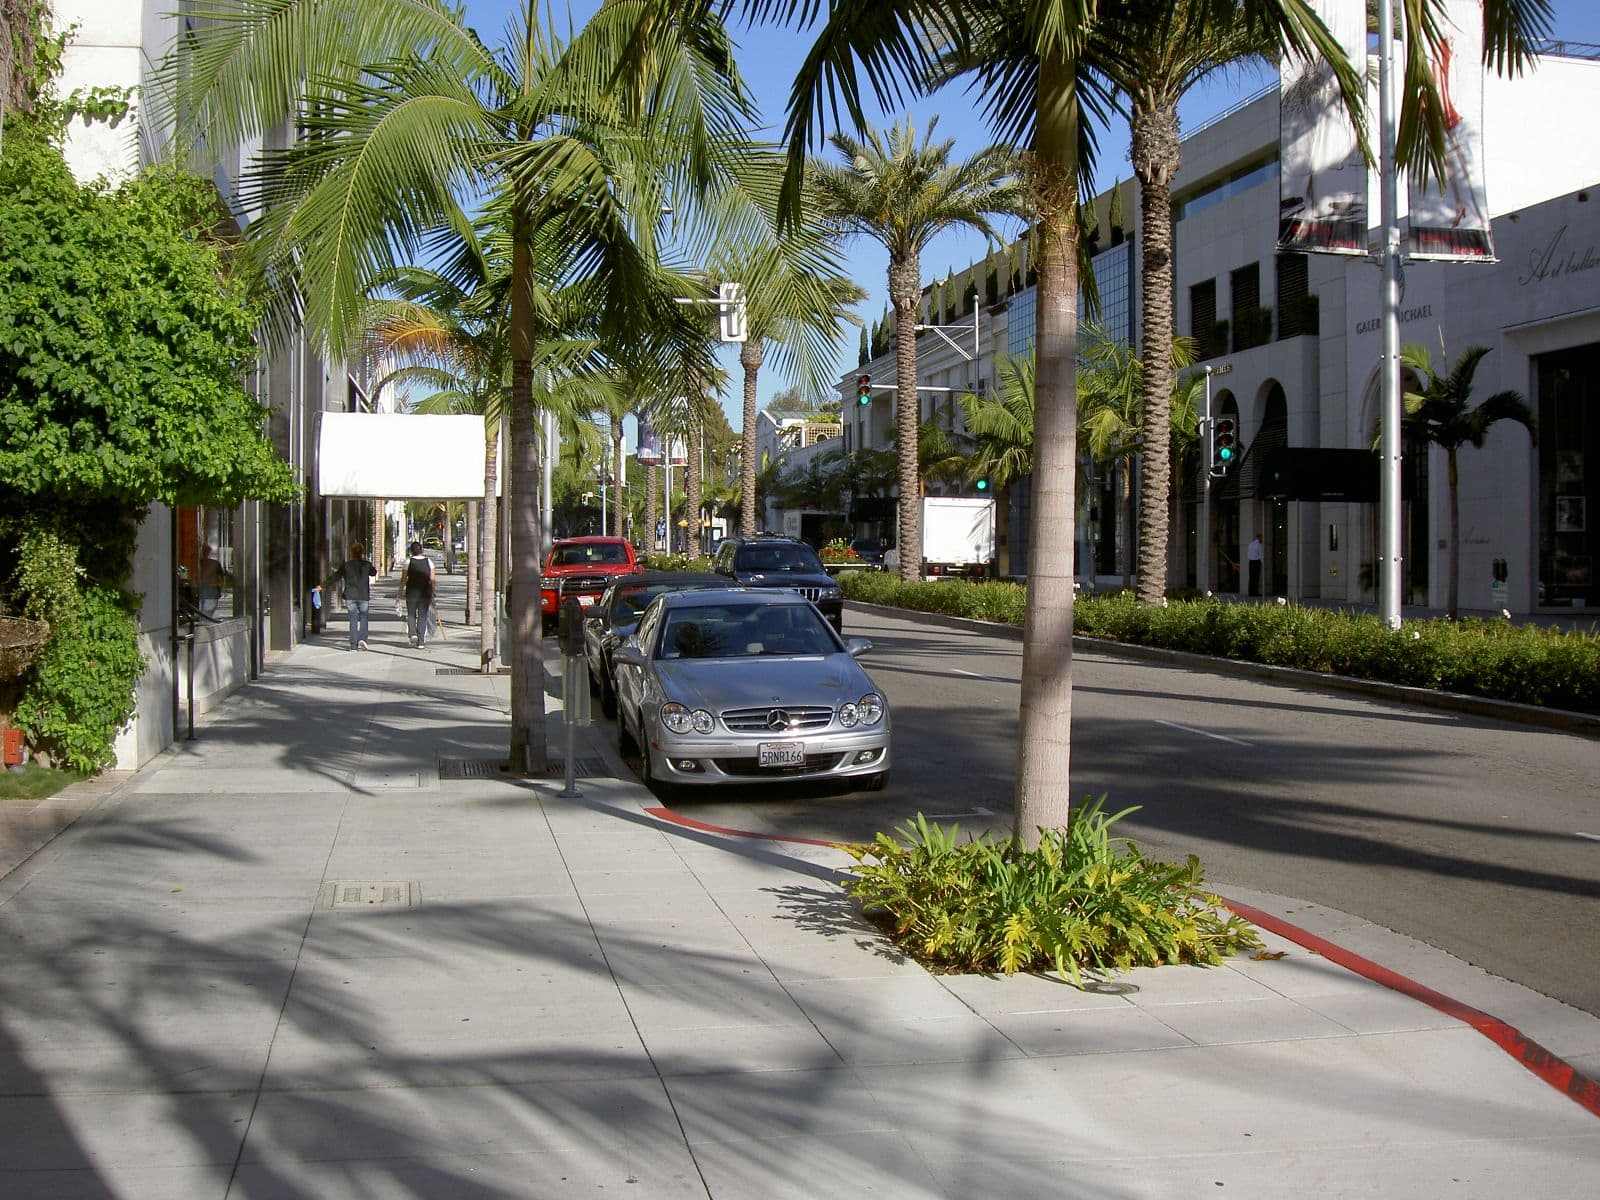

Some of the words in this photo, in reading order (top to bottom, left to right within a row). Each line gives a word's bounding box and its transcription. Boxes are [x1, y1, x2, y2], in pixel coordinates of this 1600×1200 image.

[1356, 318, 1381, 335] GALER
[1400, 304, 1433, 323] ICHAEL
[762, 751, 802, 763] 5RNR166
